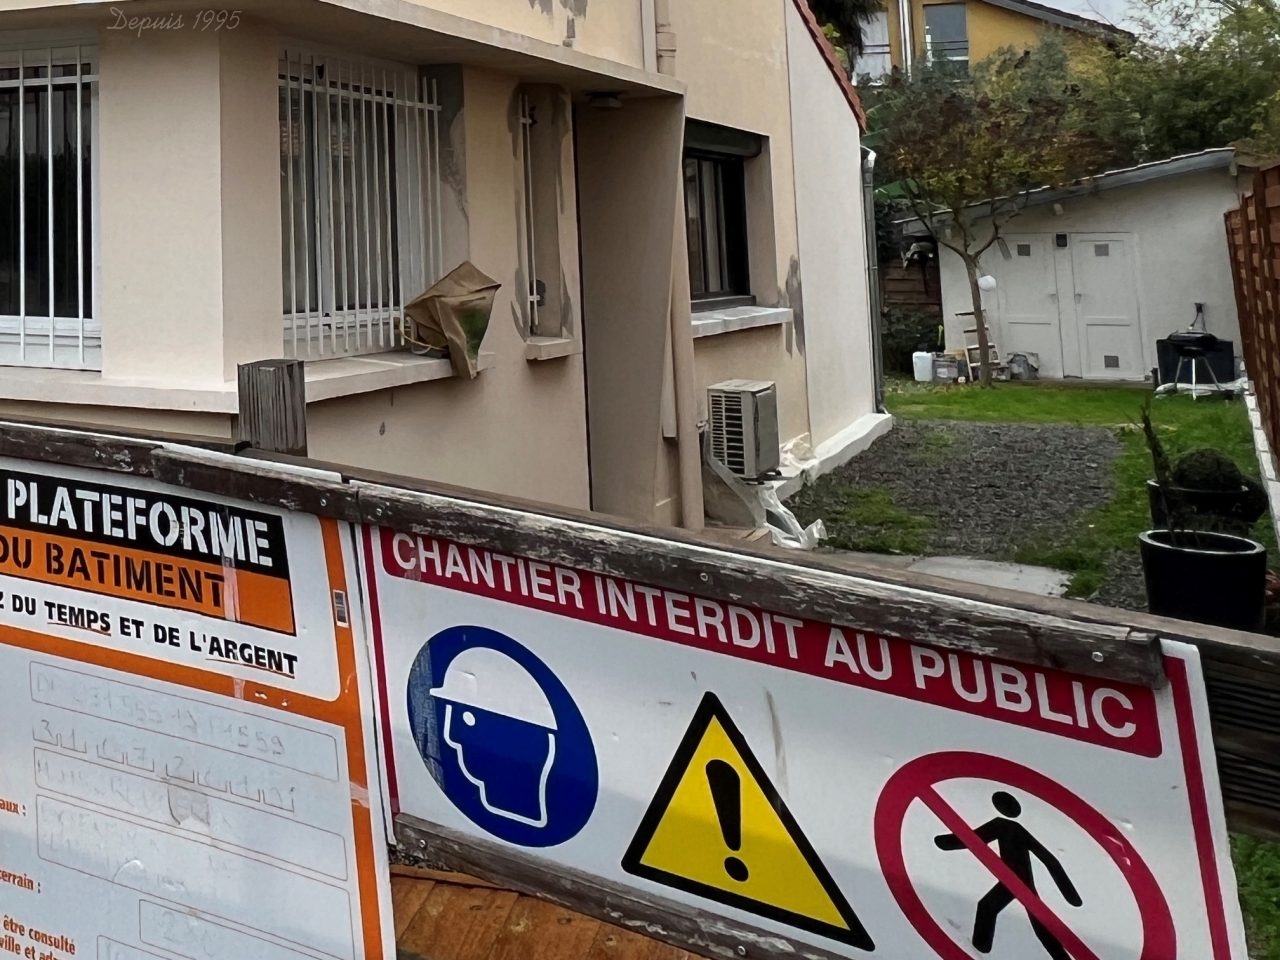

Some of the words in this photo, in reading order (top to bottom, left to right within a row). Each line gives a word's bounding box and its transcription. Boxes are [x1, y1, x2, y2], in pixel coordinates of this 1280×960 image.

[7, 478, 273, 567] PLATEFORME
[46, 542, 225, 608] BATIMENT
[12, 594, 37, 616] DU
[44, 600, 111, 632] TEMPS
[120, 616, 145, 639] ET
[154, 623, 180, 648] DE
[189, 631, 298, 675] L'ARGENT
[391, 533, 585, 610] CHANTIER
[595, 575, 804, 660] INTERDIT
[824, 627, 893, 681] AU
[910, 644, 1137, 739] PUBLIC
[3, 914, 25, 937] être
[28, 927, 76, 956] consulté
[24, 944, 36, 960] et
